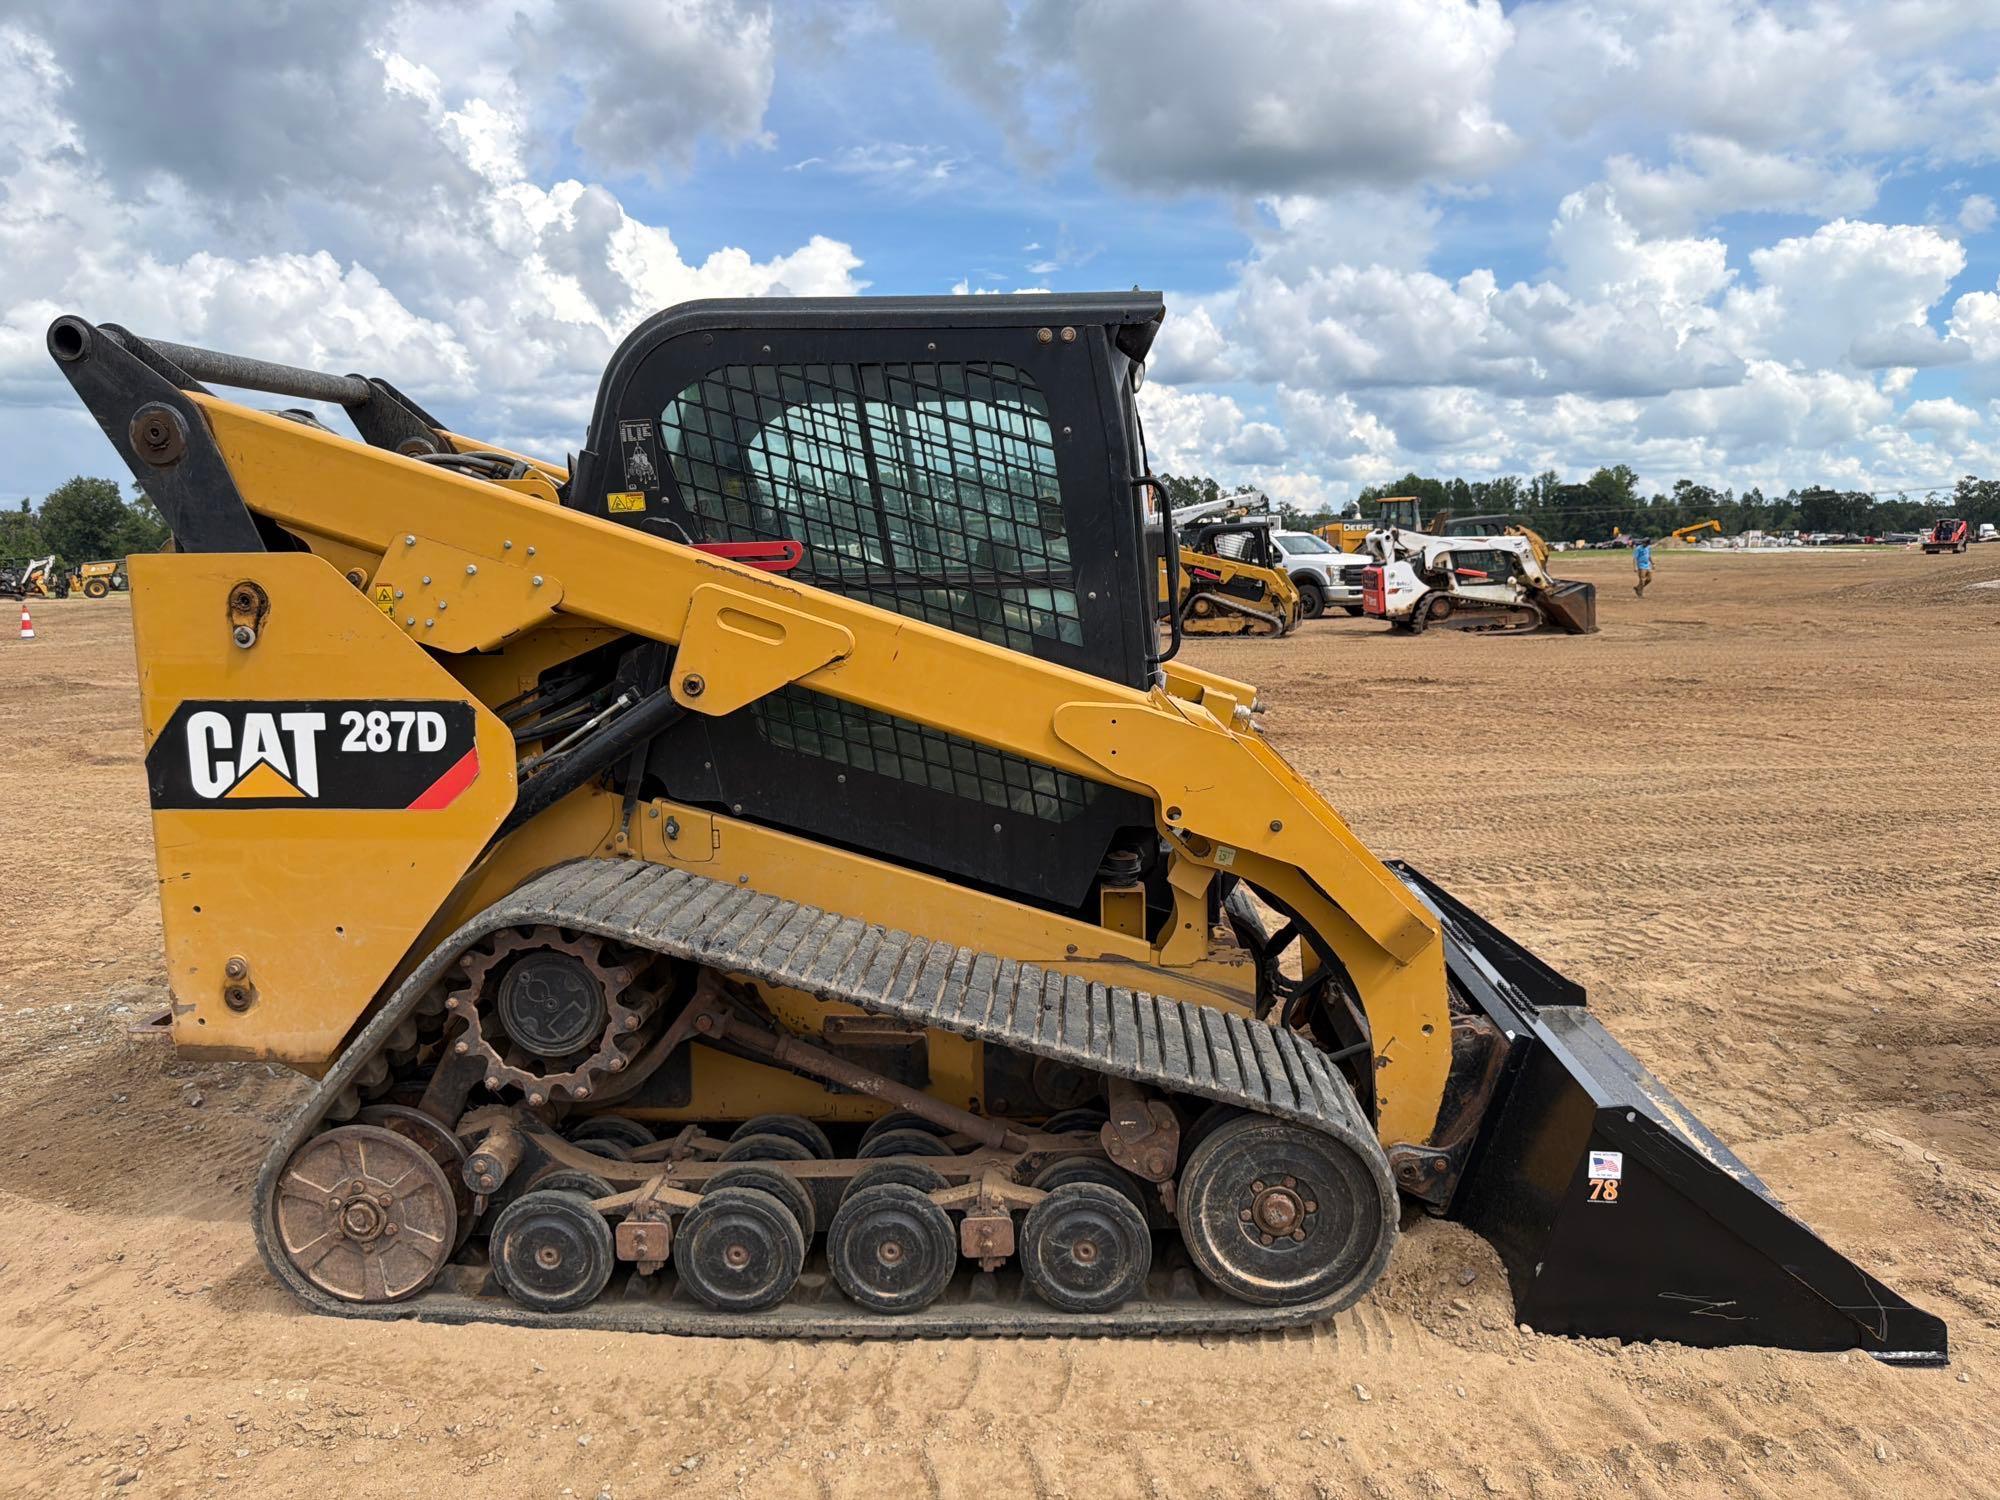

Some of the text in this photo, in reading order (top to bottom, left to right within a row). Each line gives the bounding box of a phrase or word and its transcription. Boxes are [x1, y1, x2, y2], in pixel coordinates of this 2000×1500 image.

[1343, 523, 1374, 531] DEERE
[186, 710, 447, 799] CAT 287D
[1589, 1179, 1618, 1200] 78
